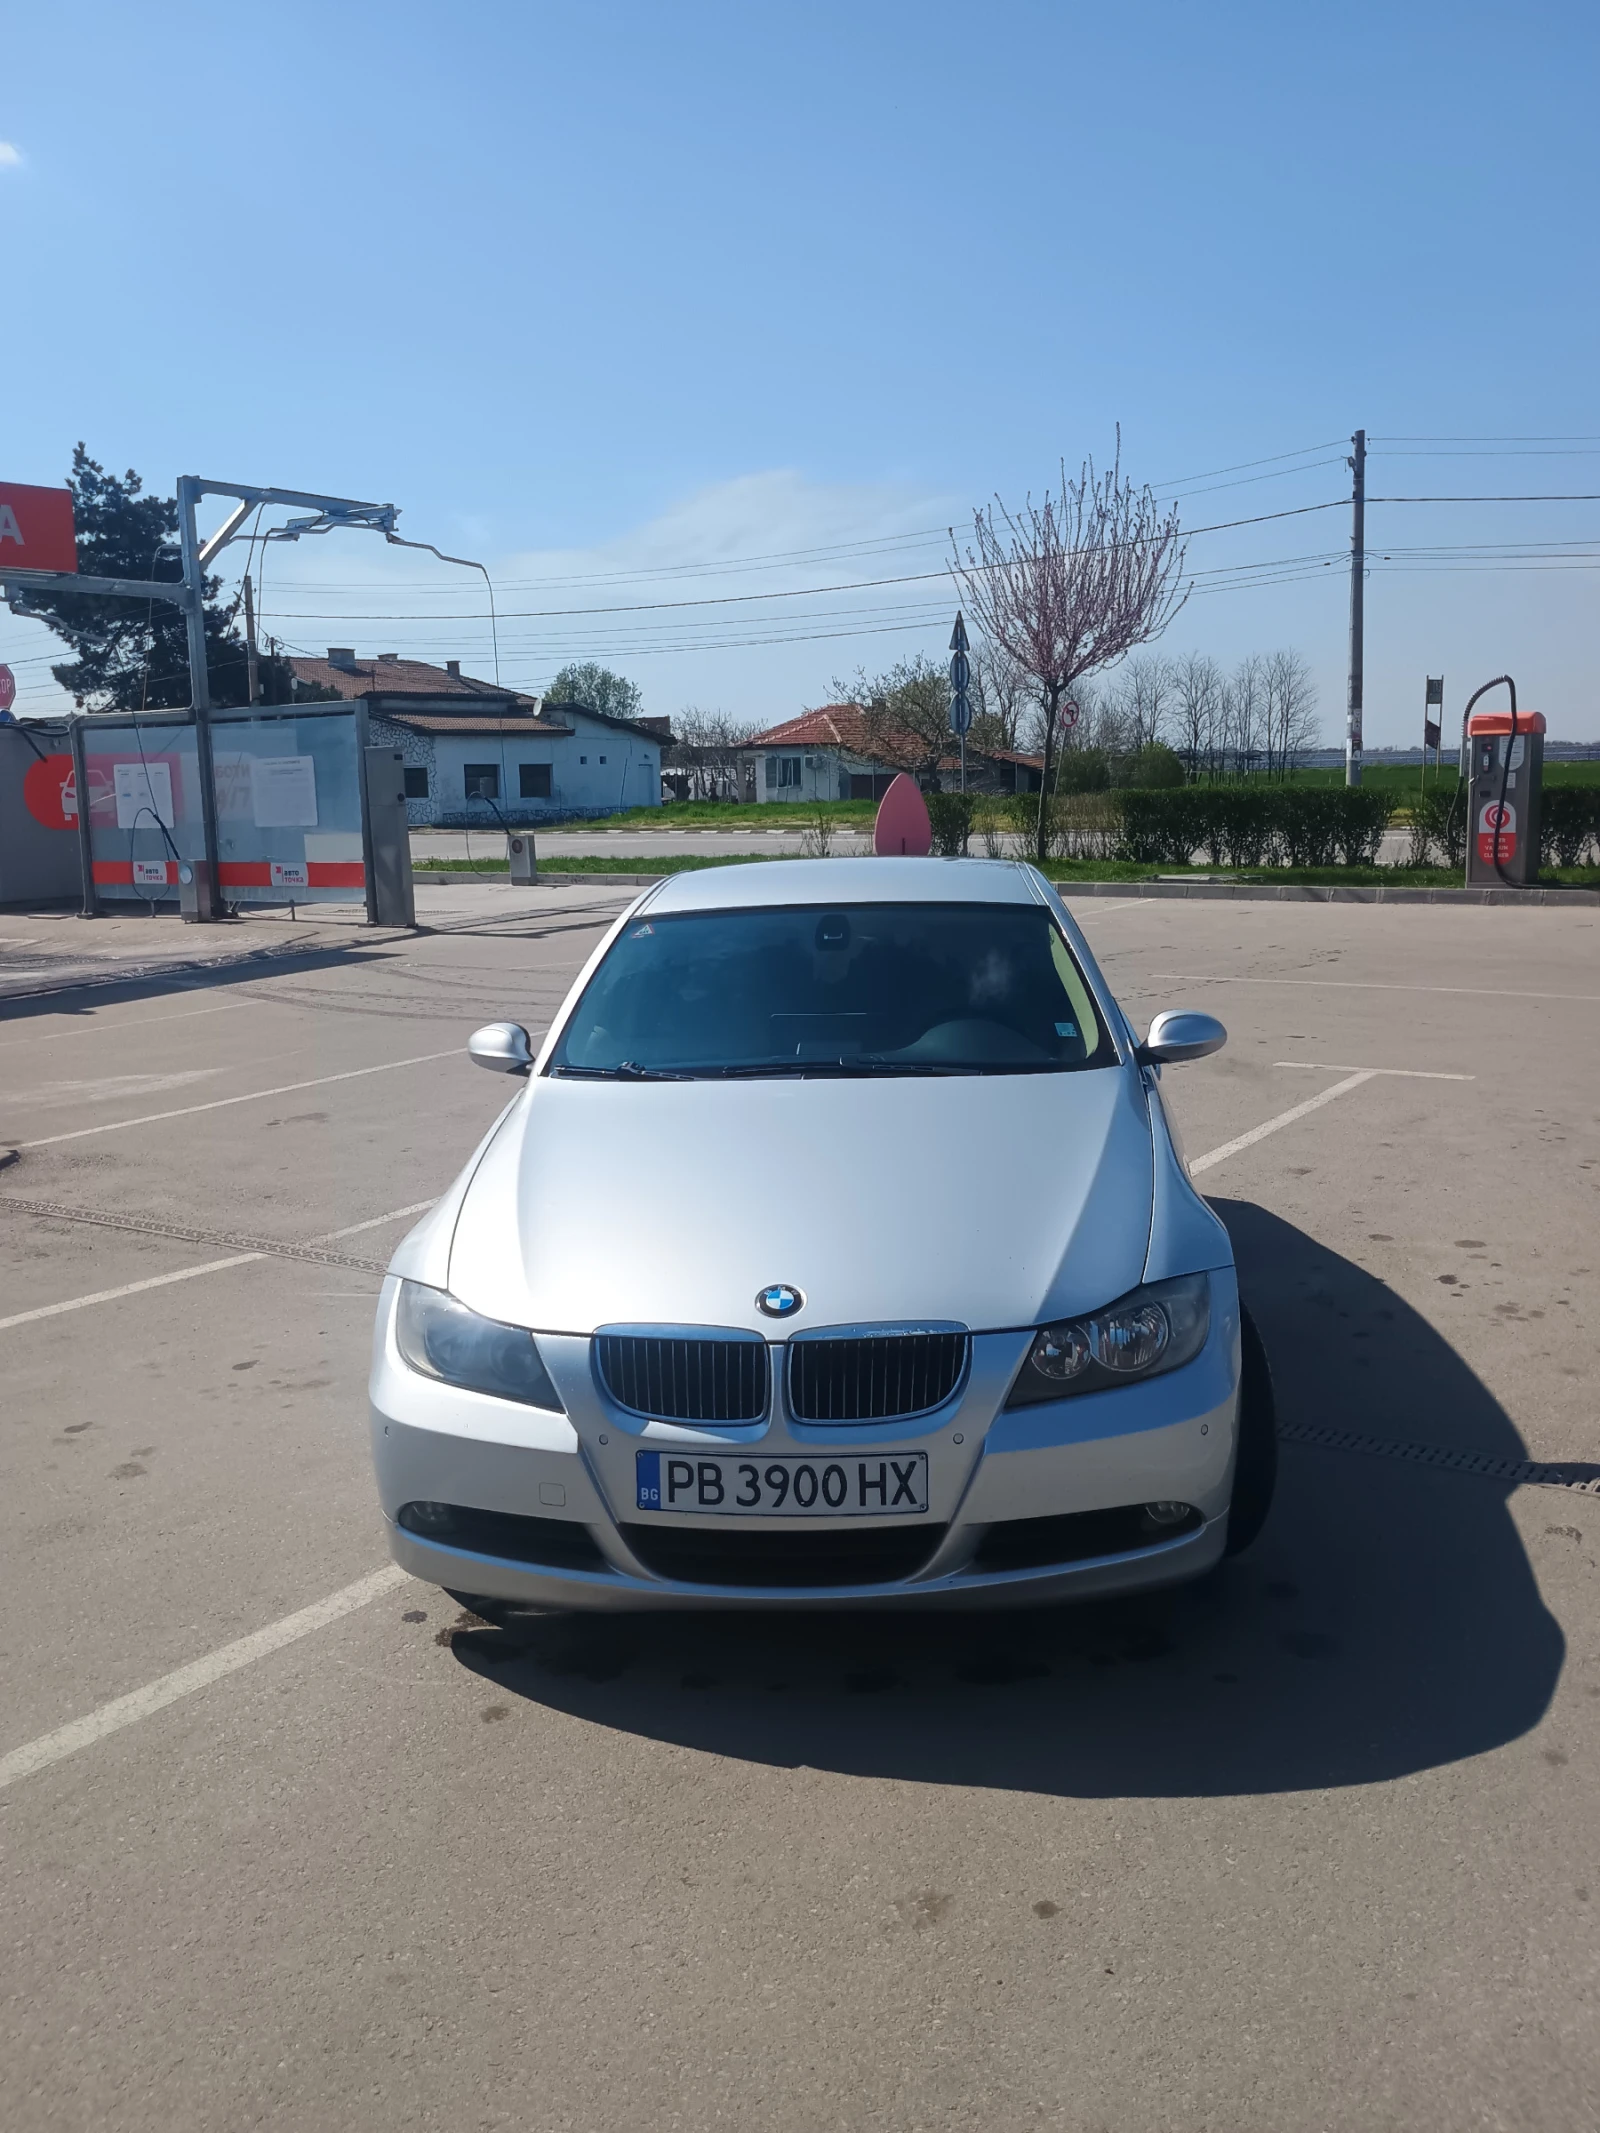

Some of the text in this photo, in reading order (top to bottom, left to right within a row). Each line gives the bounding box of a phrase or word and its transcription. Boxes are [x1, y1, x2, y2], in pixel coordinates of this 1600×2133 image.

[640, 1487, 659, 1501] BG
[667, 1460, 918, 1508] PB 3900 HX
